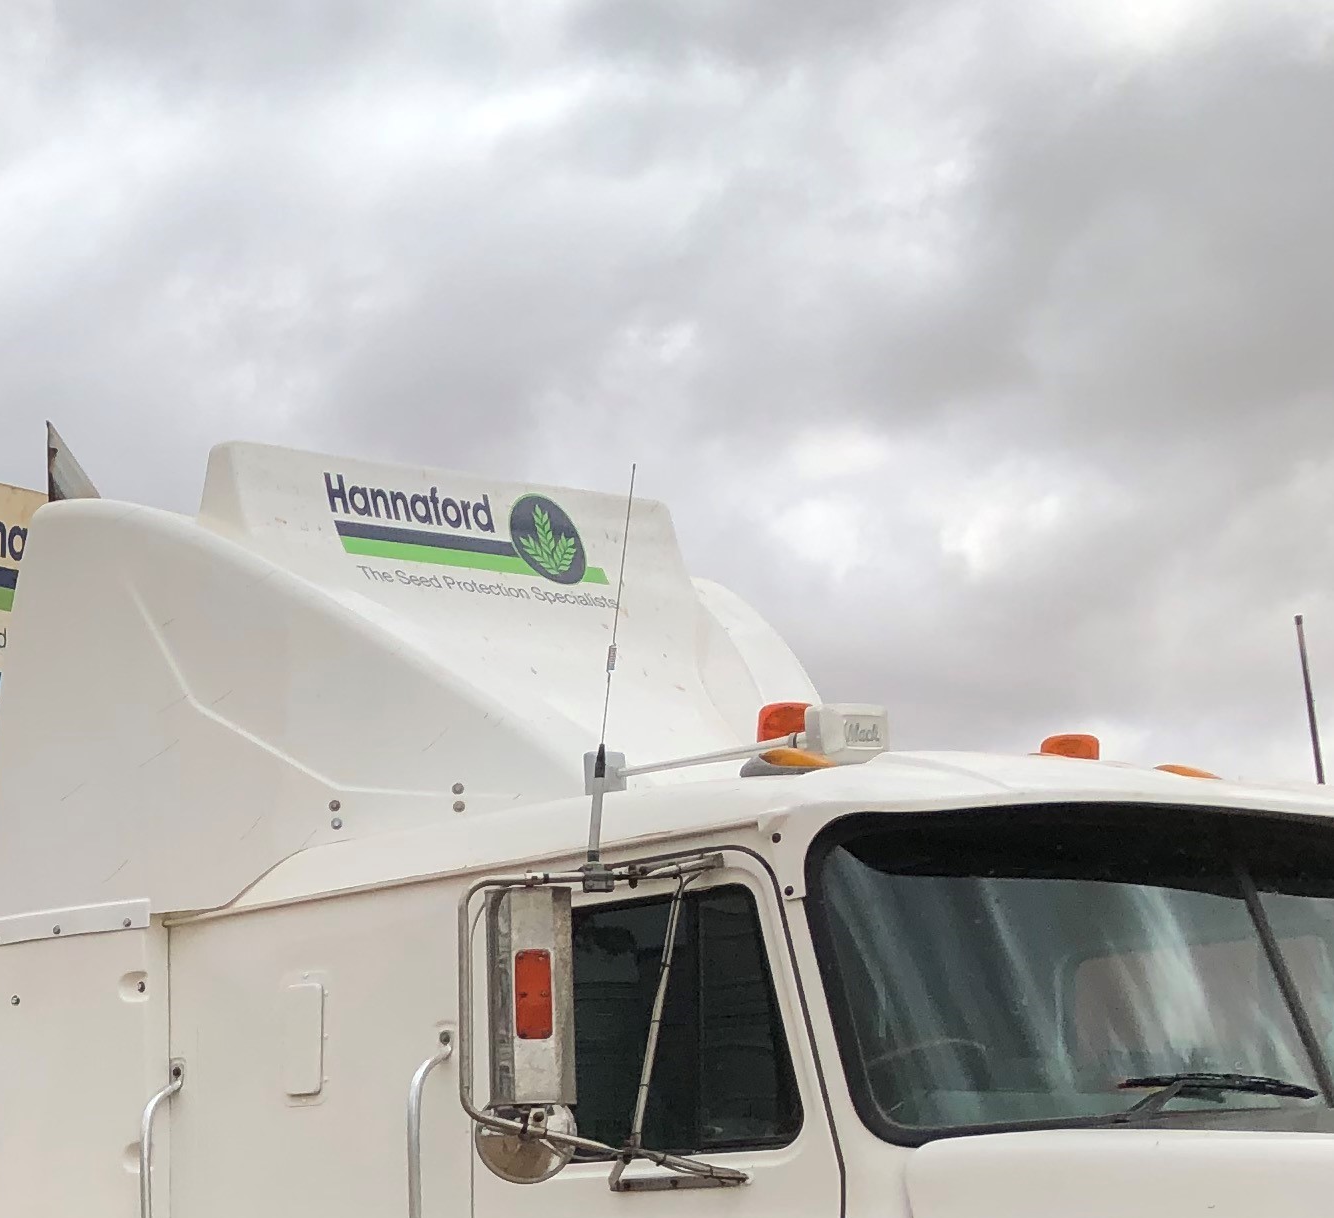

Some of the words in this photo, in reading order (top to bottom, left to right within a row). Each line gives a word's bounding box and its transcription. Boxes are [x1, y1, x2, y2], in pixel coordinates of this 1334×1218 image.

[323, 472, 496, 533] Hannaford
[356, 564, 394, 583] The
[395, 569, 443, 588] Seed
[442, 575, 531, 600] Protection
[531, 587, 619, 610] Specialists
